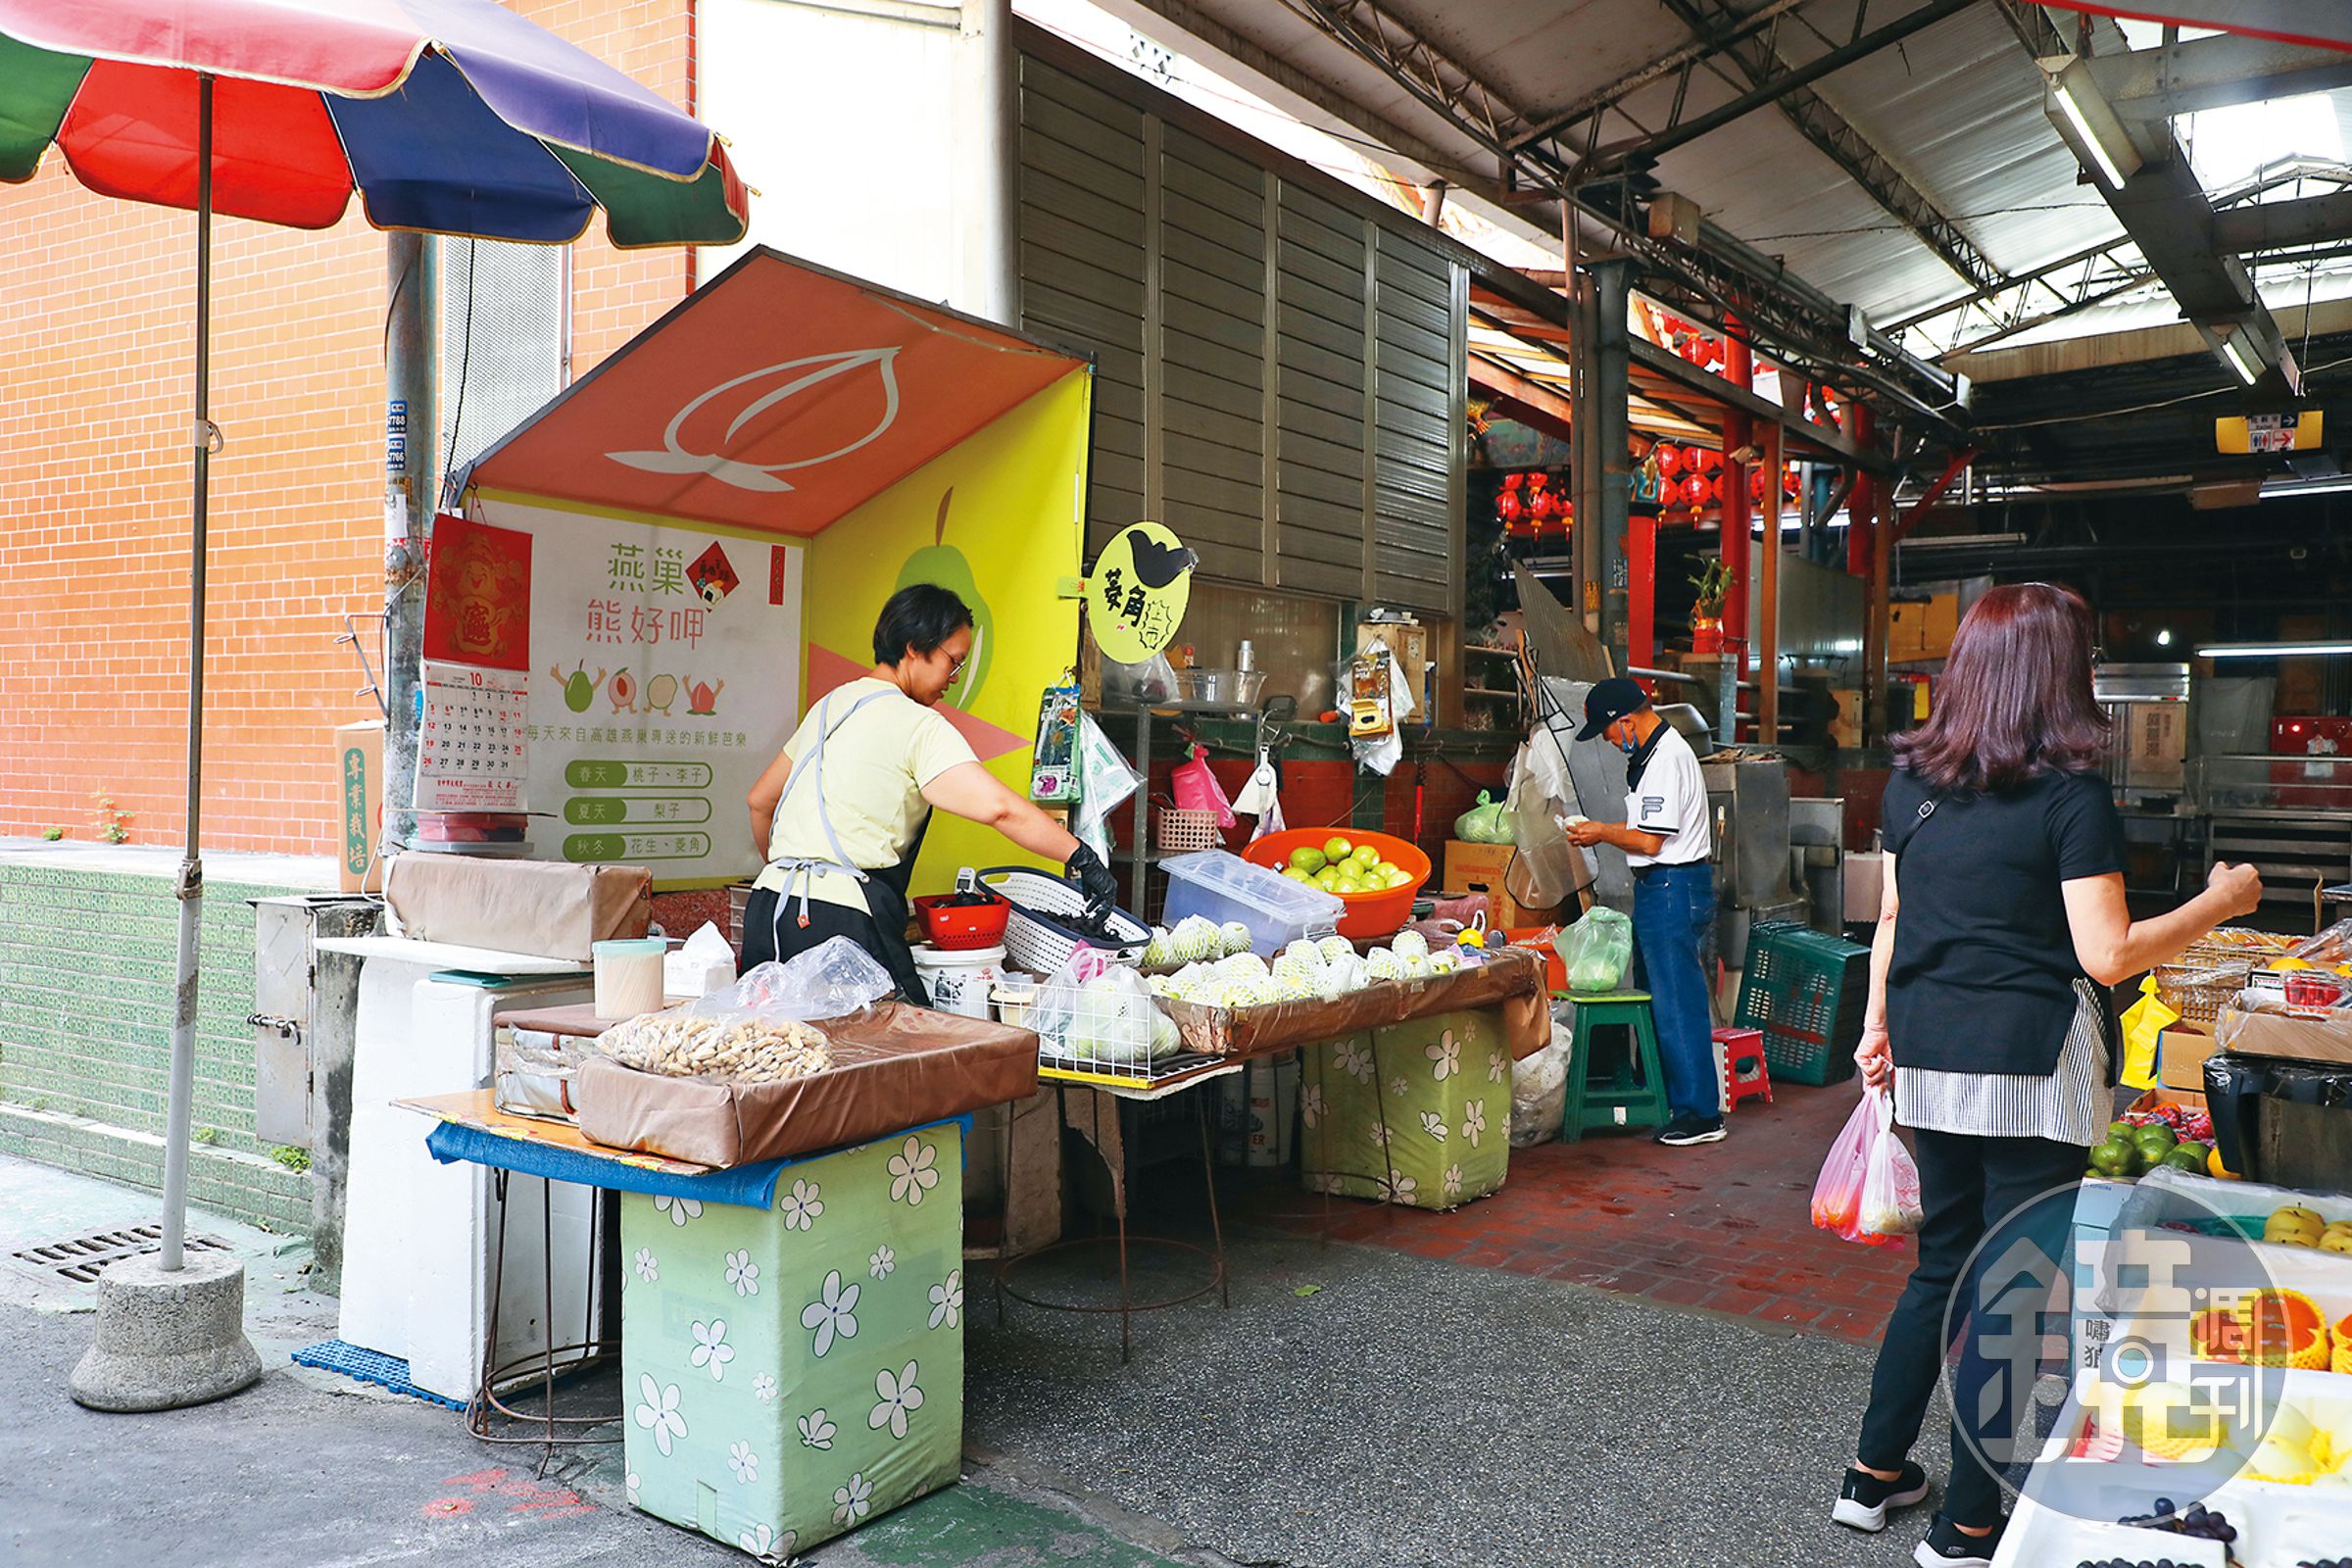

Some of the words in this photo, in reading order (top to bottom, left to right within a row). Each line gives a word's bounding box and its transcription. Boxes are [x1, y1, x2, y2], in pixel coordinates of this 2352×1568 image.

[607, 543, 684, 595] 燕巢
[1104, 568, 1147, 627] 菱角
[586, 599, 704, 650] 熊好呷
[470, 672, 482, 686] 10
[579, 766, 606, 782] 春天
[632, 766, 702, 783] 桃子、李子
[346, 752, 367, 868] 專業栽培
[578, 804, 606, 819] 夏天
[654, 802, 680, 819] 梨子
[577, 839, 605, 856] 秋冬
[631, 837, 701, 854] 花生、菱角
